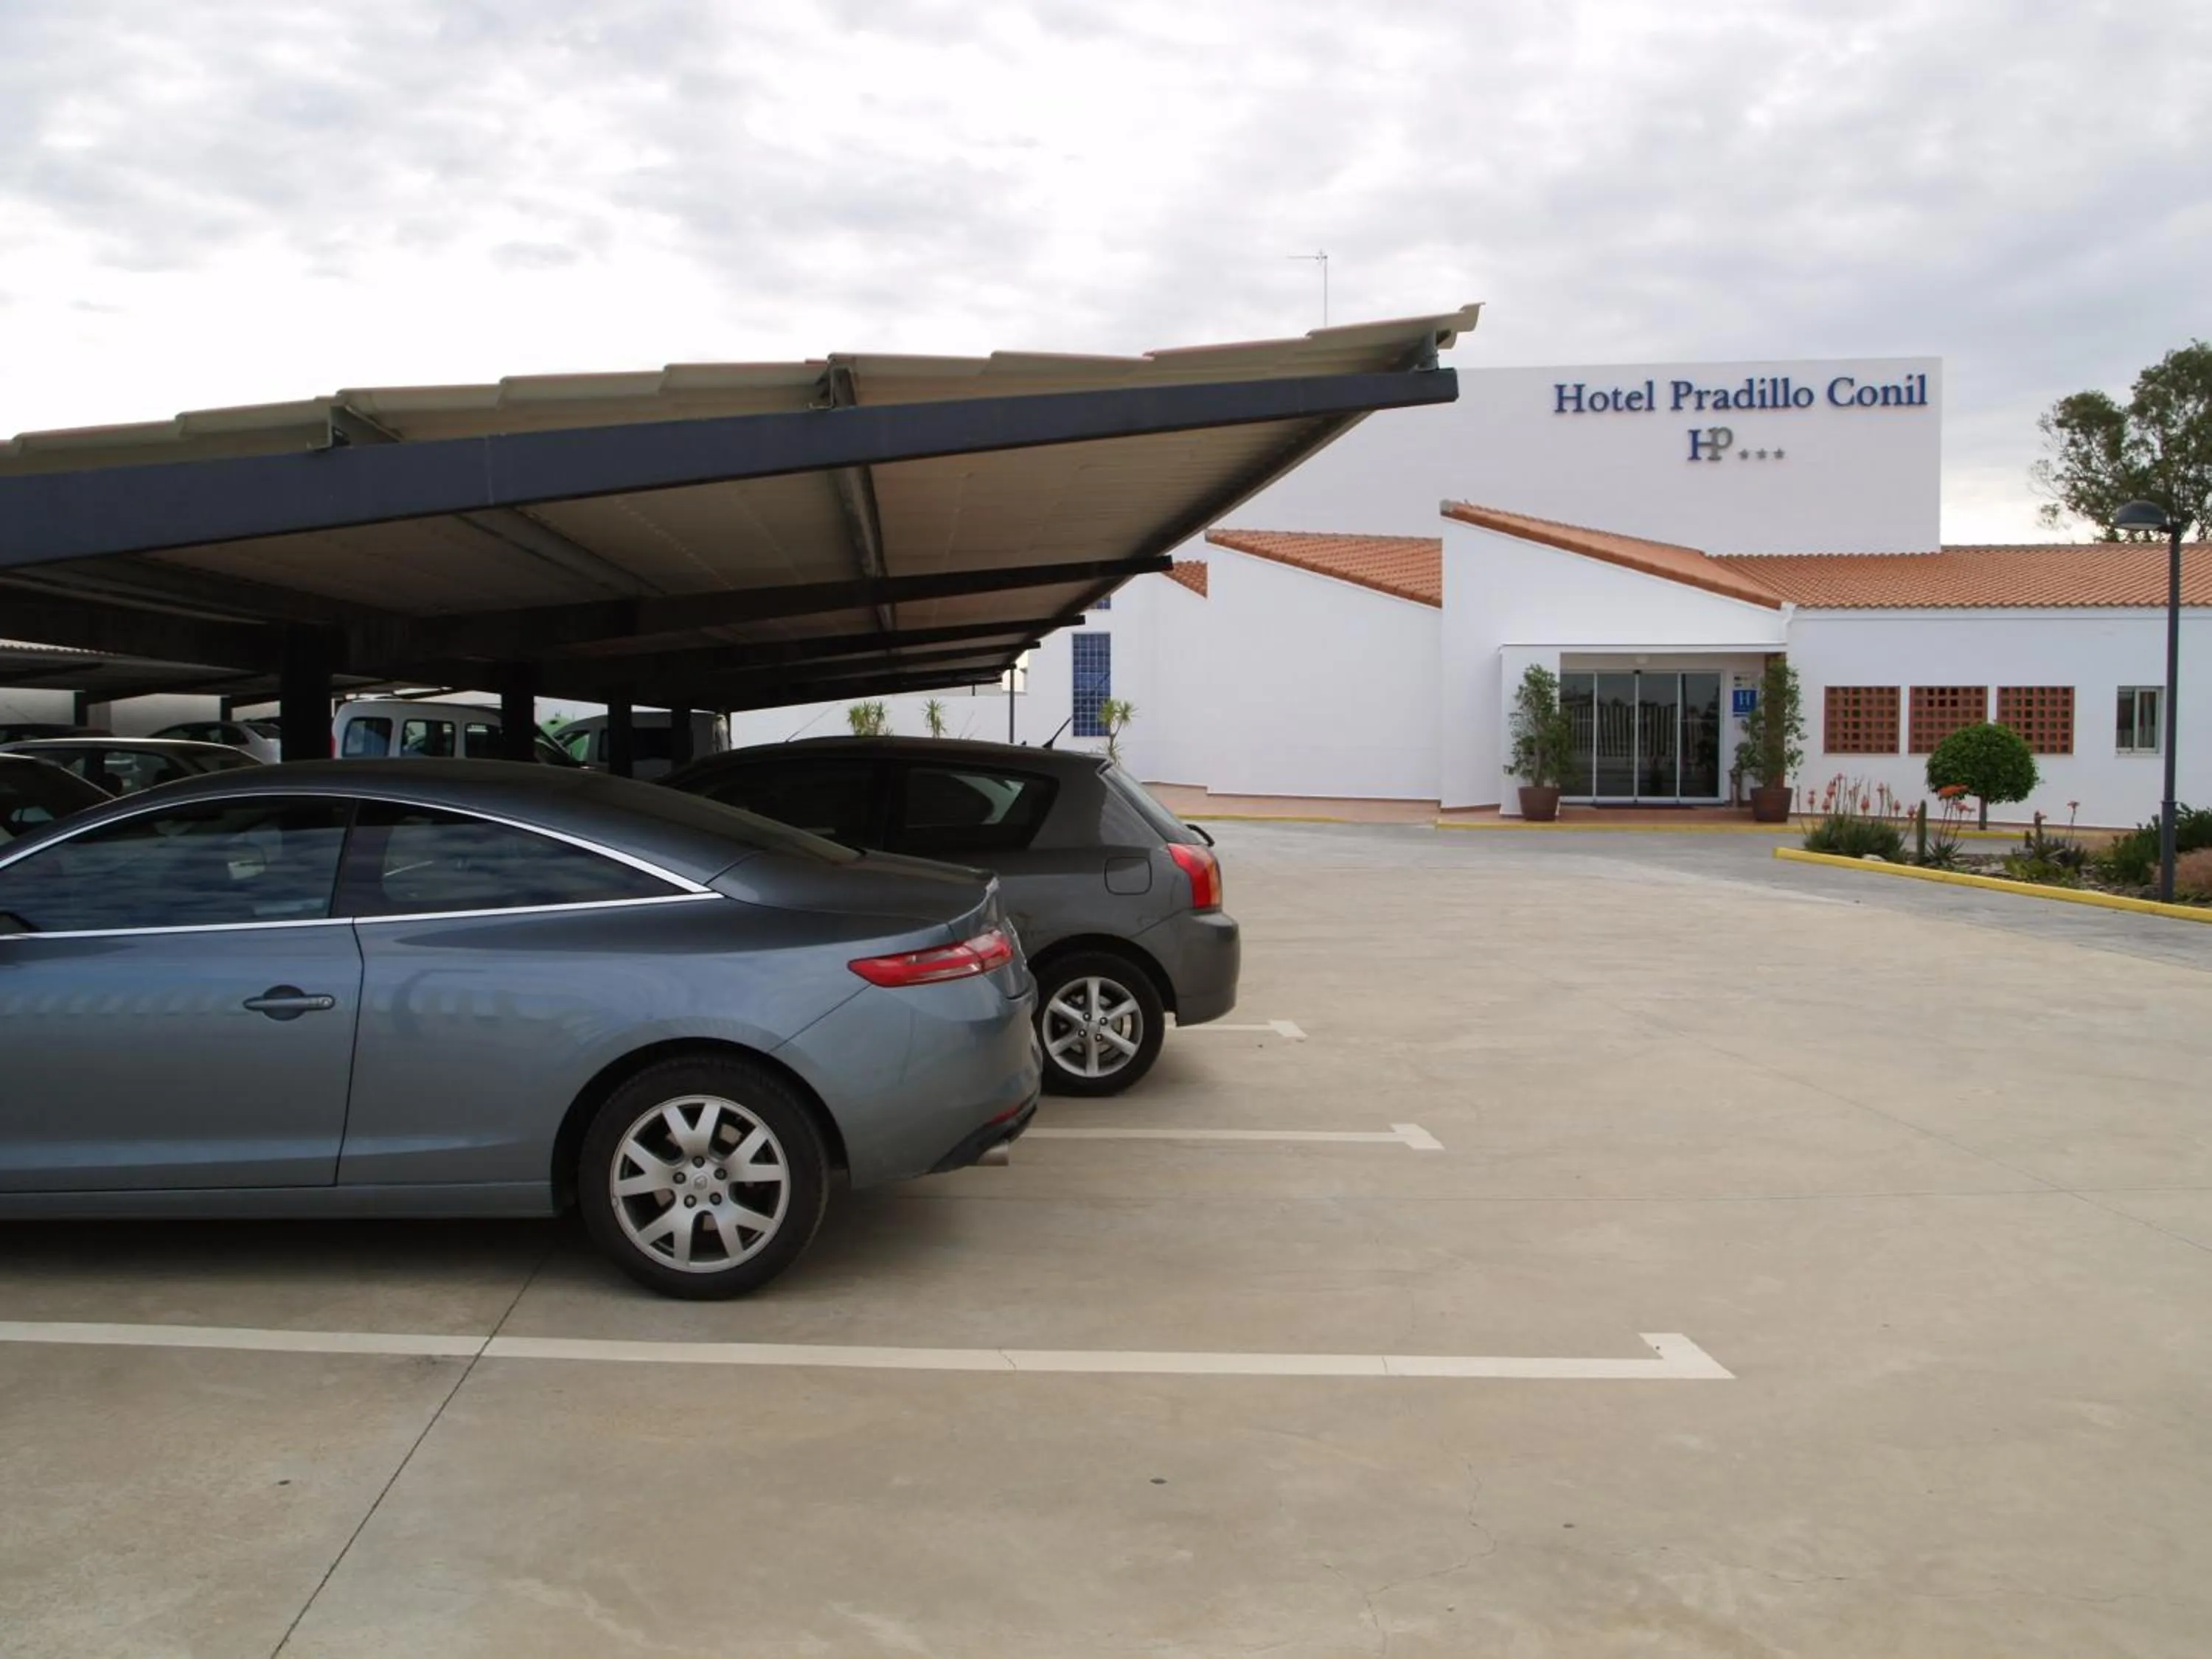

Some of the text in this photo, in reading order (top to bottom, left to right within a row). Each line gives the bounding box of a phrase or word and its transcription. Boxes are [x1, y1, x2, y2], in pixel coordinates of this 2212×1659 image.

[1554, 373, 1929, 414] Hotel Pradillo Conil
